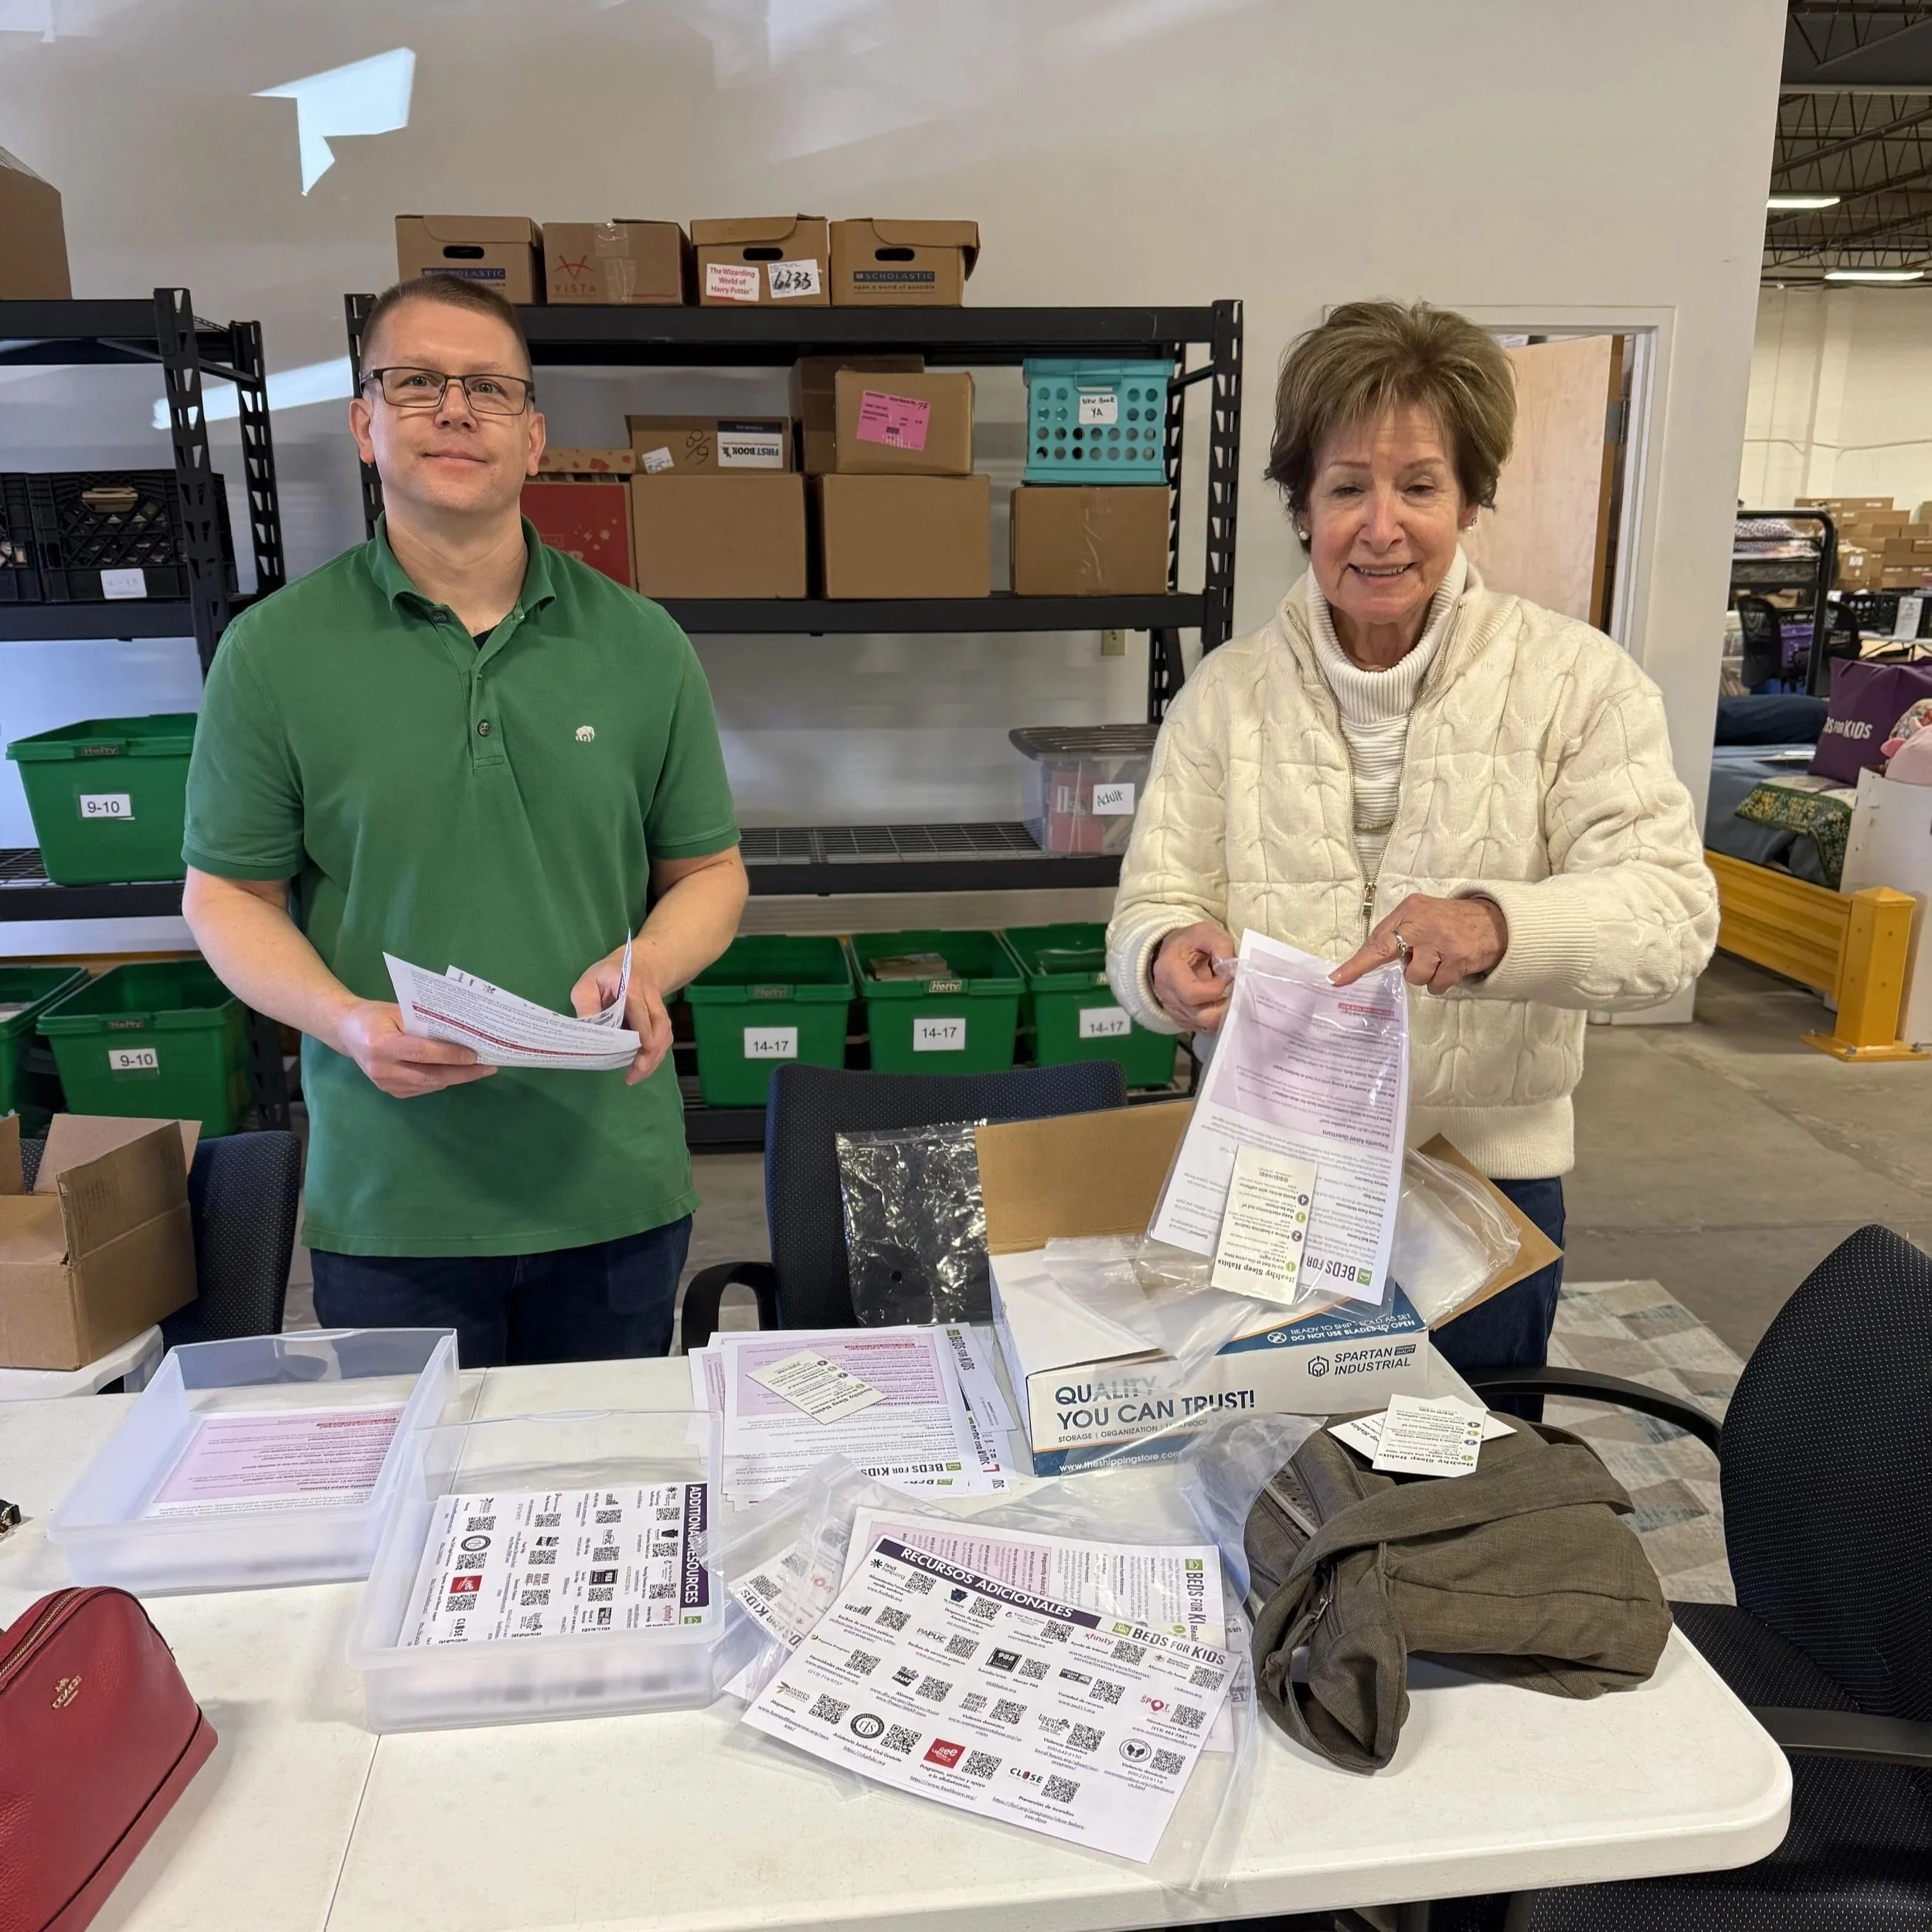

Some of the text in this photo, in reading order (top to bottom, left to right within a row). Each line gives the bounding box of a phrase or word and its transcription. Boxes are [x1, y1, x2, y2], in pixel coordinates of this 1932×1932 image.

[723, 268, 755, 277] Wizarding
[1091, 408, 1103, 417] YA
[733, 447, 779, 456] FIRST BOOK
[1843, 719, 1873, 739] KIDS
[83, 747, 117, 756] Hefty
[1097, 790, 1123, 807] Adult
[87, 801, 120, 813] 9-10
[932, 981, 960, 992] Hefty
[922, 1027, 957, 1039] 14-17
[1090, 1021, 1124, 1033] 14-17
[753, 1040, 789, 1053] 14-17
[120, 1055, 154, 1066] 9-10
[1216, 1258, 1241, 1270] Habits
[1243, 1263, 1264, 1276] Sleep
[1305, 1256, 1356, 1281] BEDS FOR
[1392, 1320, 1415, 1328] OPEN
[1334, 1348, 1393, 1363] SPARTAN
[1334, 1357, 1411, 1376] INDUSTRIAL
[1055, 1376, 1157, 1406] QUALITY
[1056, 1389, 1256, 1430] YOU CAN TRUST!
[1058, 1433, 1093, 1443] STORAGE
[1100, 1425, 1158, 1438] ORGANIZATION
[860, 1462, 944, 1477] BEDS FOR KIDS
[879, 1566, 906, 1580] help.org
[883, 1562, 896, 1571] find
[1037, 1552, 1050, 1590] Frequently Asked
[900, 1547, 978, 1591] RECURSOS
[975, 1576, 1073, 1621] ADICIONALES
[1185, 1571, 1206, 1625] BEDS FOR KI
[1083, 1631, 1114, 1647] xfinity
[1131, 1627, 1226, 1666] BEDS FOR KIDS
[997, 1651, 1015, 1662] 988
[962, 1696, 987, 1709] AGAINST
[966, 1691, 988, 1702] WOMEN
[960, 1702, 978, 1713] ABUSE
